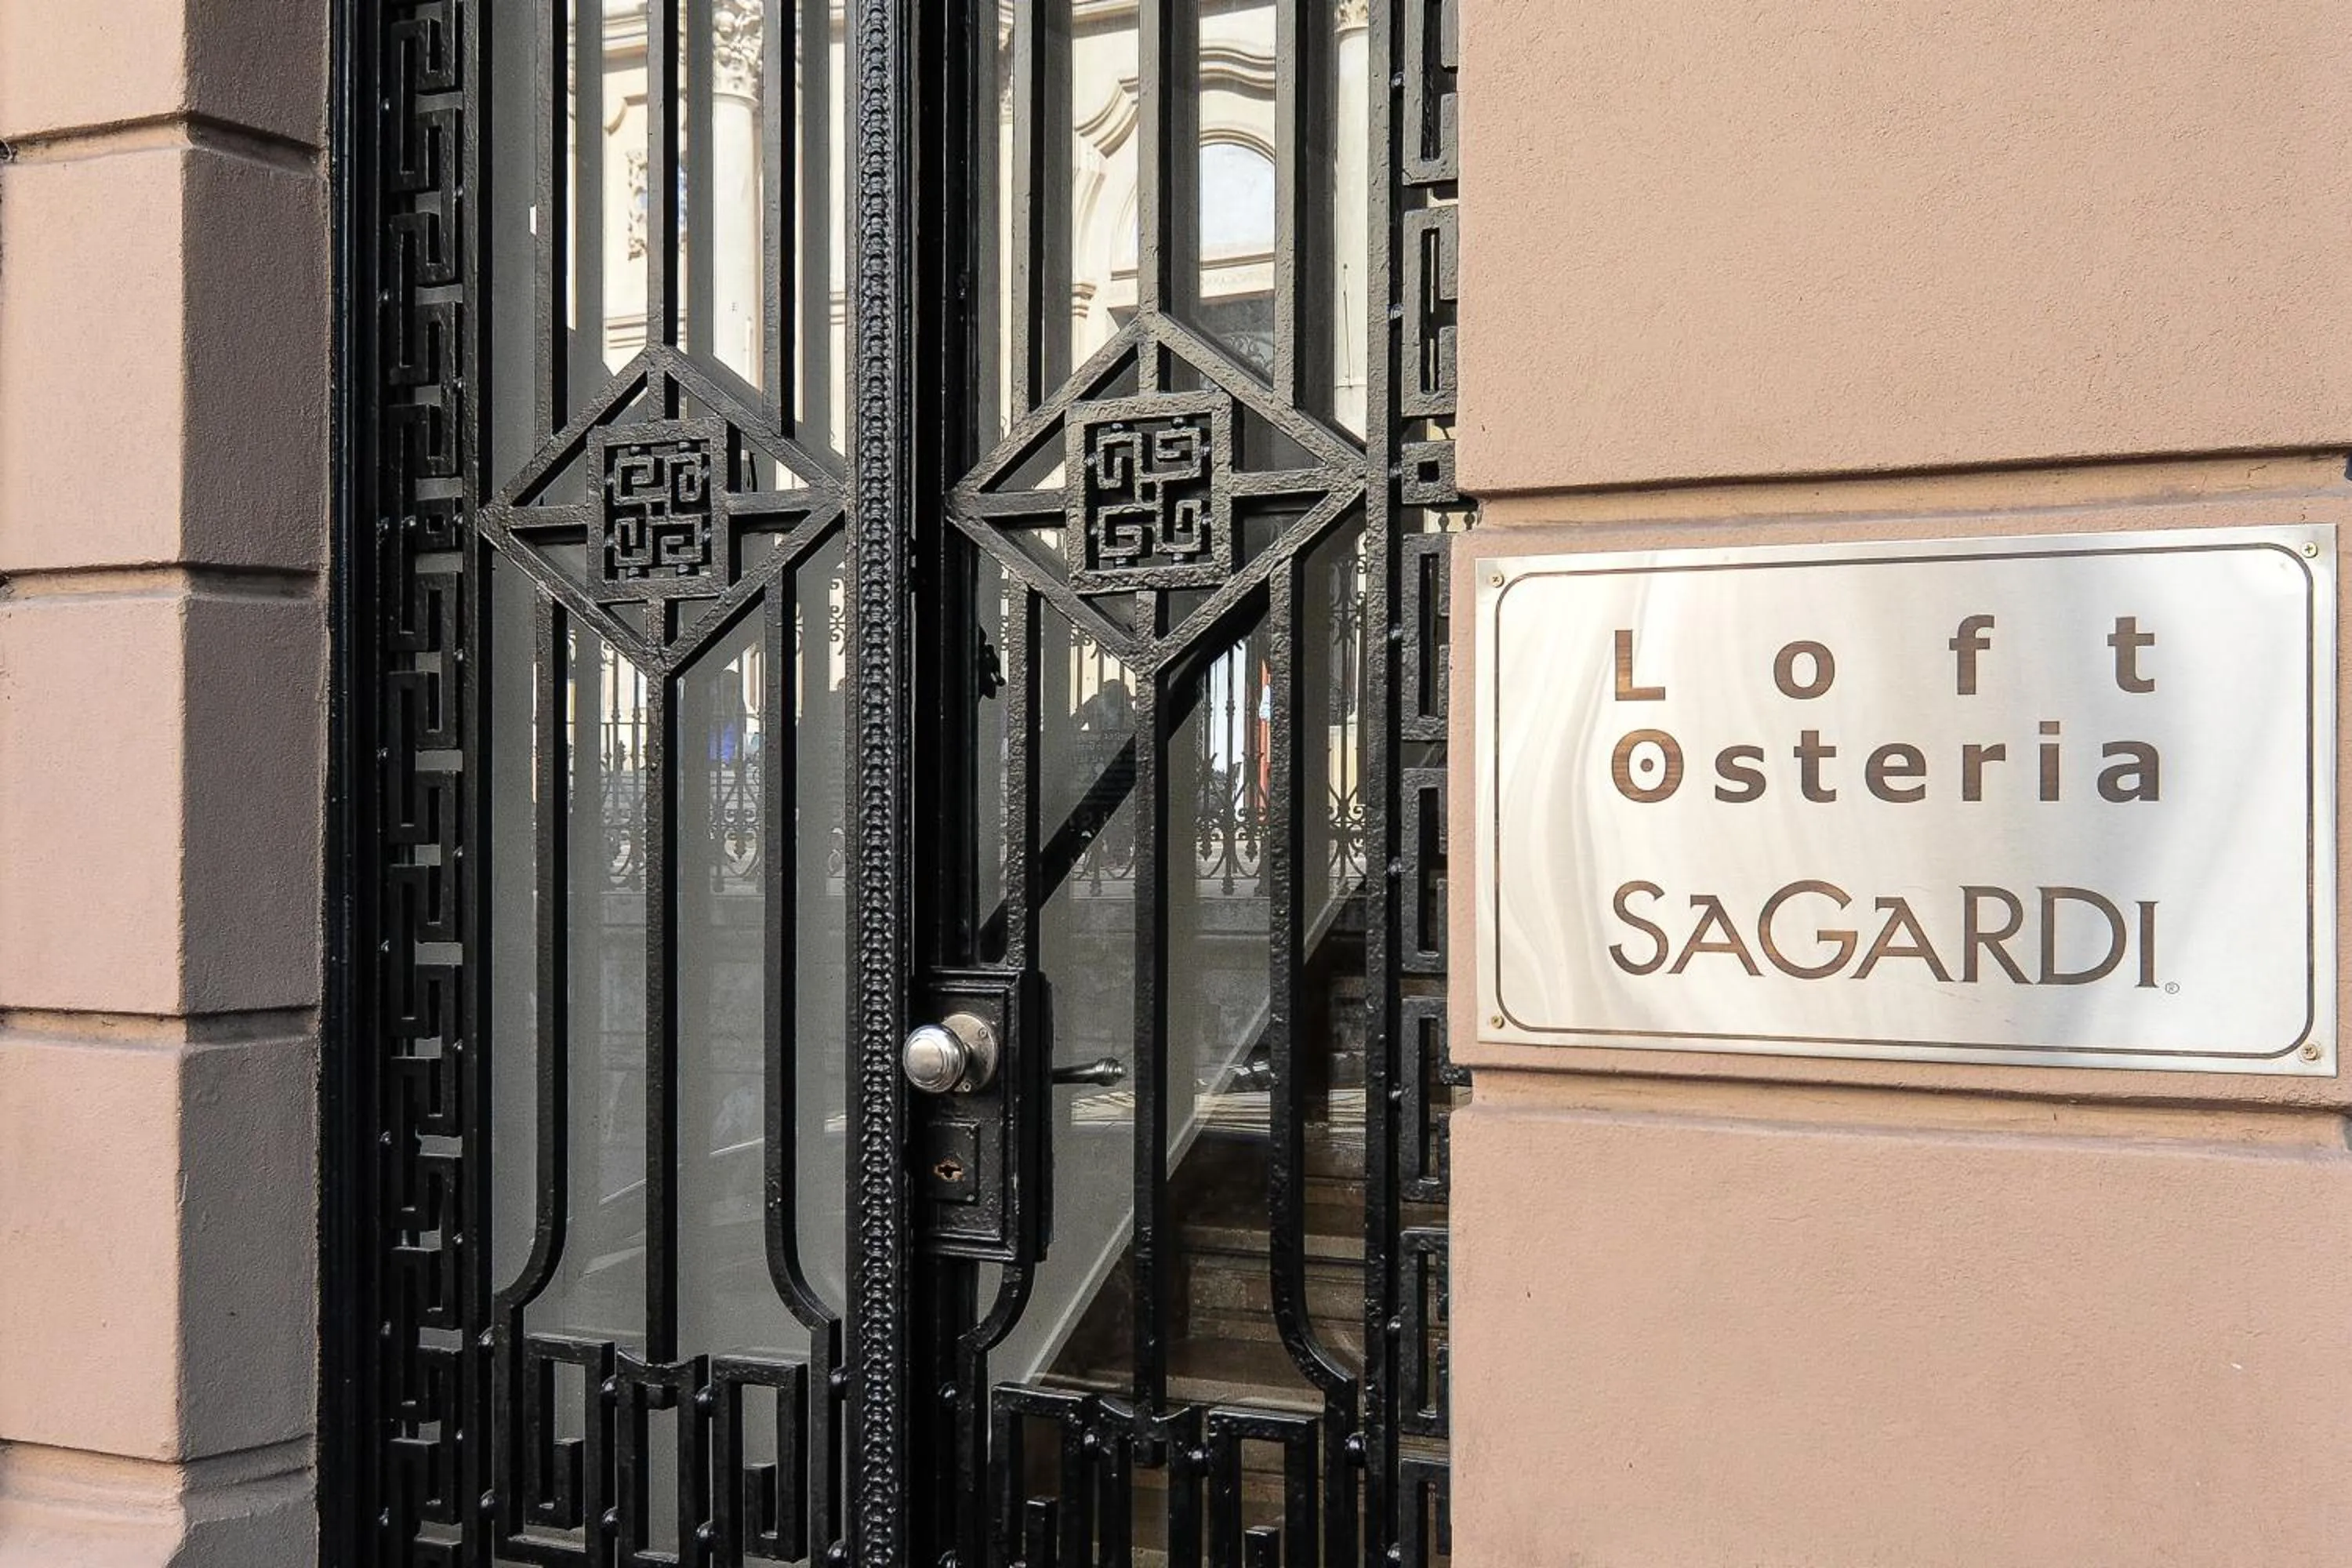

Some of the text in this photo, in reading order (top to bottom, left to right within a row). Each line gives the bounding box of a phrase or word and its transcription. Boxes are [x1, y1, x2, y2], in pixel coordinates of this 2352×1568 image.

[1613, 614, 2156, 702] Loft
[1611, 720, 2161, 804] Osteria
[1608, 880, 2160, 989] SAGARDI
